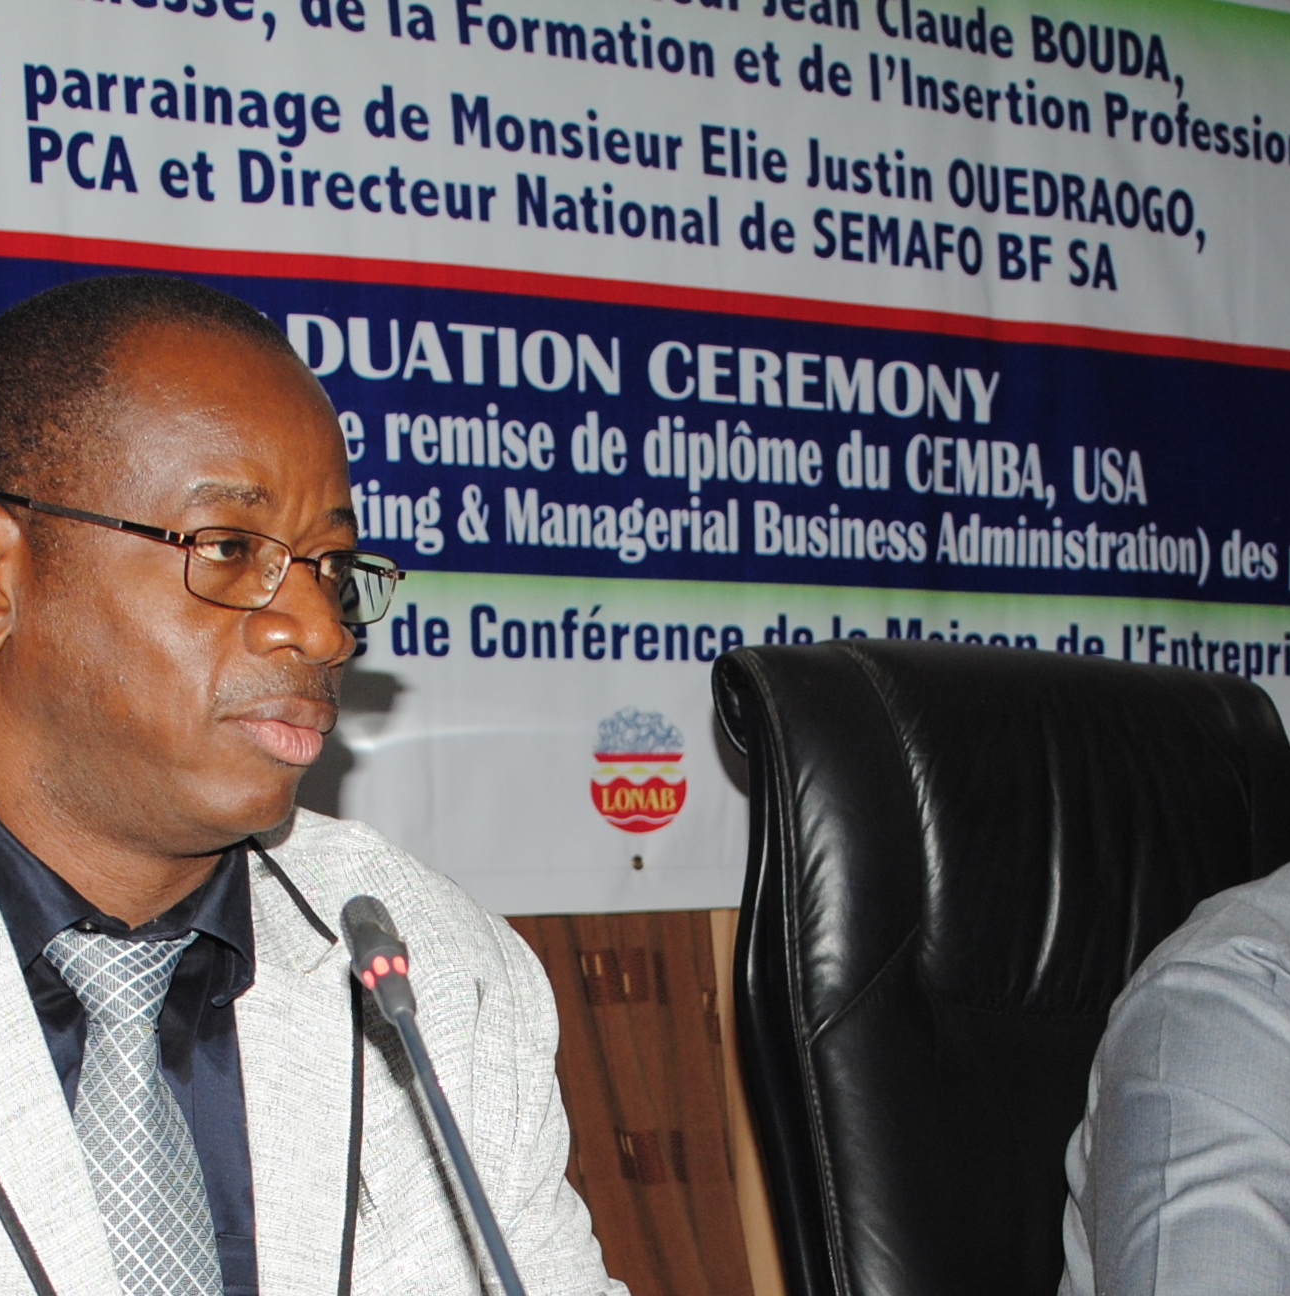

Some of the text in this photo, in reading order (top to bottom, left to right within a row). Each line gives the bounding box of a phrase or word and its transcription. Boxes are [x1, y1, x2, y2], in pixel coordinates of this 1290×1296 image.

[388, 0, 436, 42] la
[456, 0, 716, 78] Formation
[734, 39, 782, 88] et
[799, 43, 853, 97] de
[868, 52, 1091, 134] l'Insertion
[876, 0, 1014, 60] Claude
[1031, 16, 1186, 95] BOUDA,
[23, 61, 342, 147] parrainage
[364, 84, 430, 141] de
[451, 92, 683, 171] Monsieur
[700, 123, 789, 185] Elie
[807, 136, 934, 203] Justin
[947, 159, 1207, 254] OUEDRAOGO,
[27, 127, 1118, 292] PCA et Directeur National de SEMAFO BF SA
[286, 313, 1001, 424] DUATION CEREMONY
[384, 403, 556, 472] remise
[570, 411, 627, 477] de
[642, 415, 823, 493] diplôme
[836, 430, 891, 491] du
[905, 432, 1056, 510] CEMBA,
[1072, 445, 1148, 505] USA
[456, 484, 494, 545] &
[504, 487, 740, 564] Managerial
[754, 500, 927, 564] Business
[935, 512, 1210, 587] Administration)
[1221, 529, 1279, 579] des
[391, 602, 450, 657] de
[469, 604, 744, 662] Conférence
[601, 787, 677, 813] LONAB
